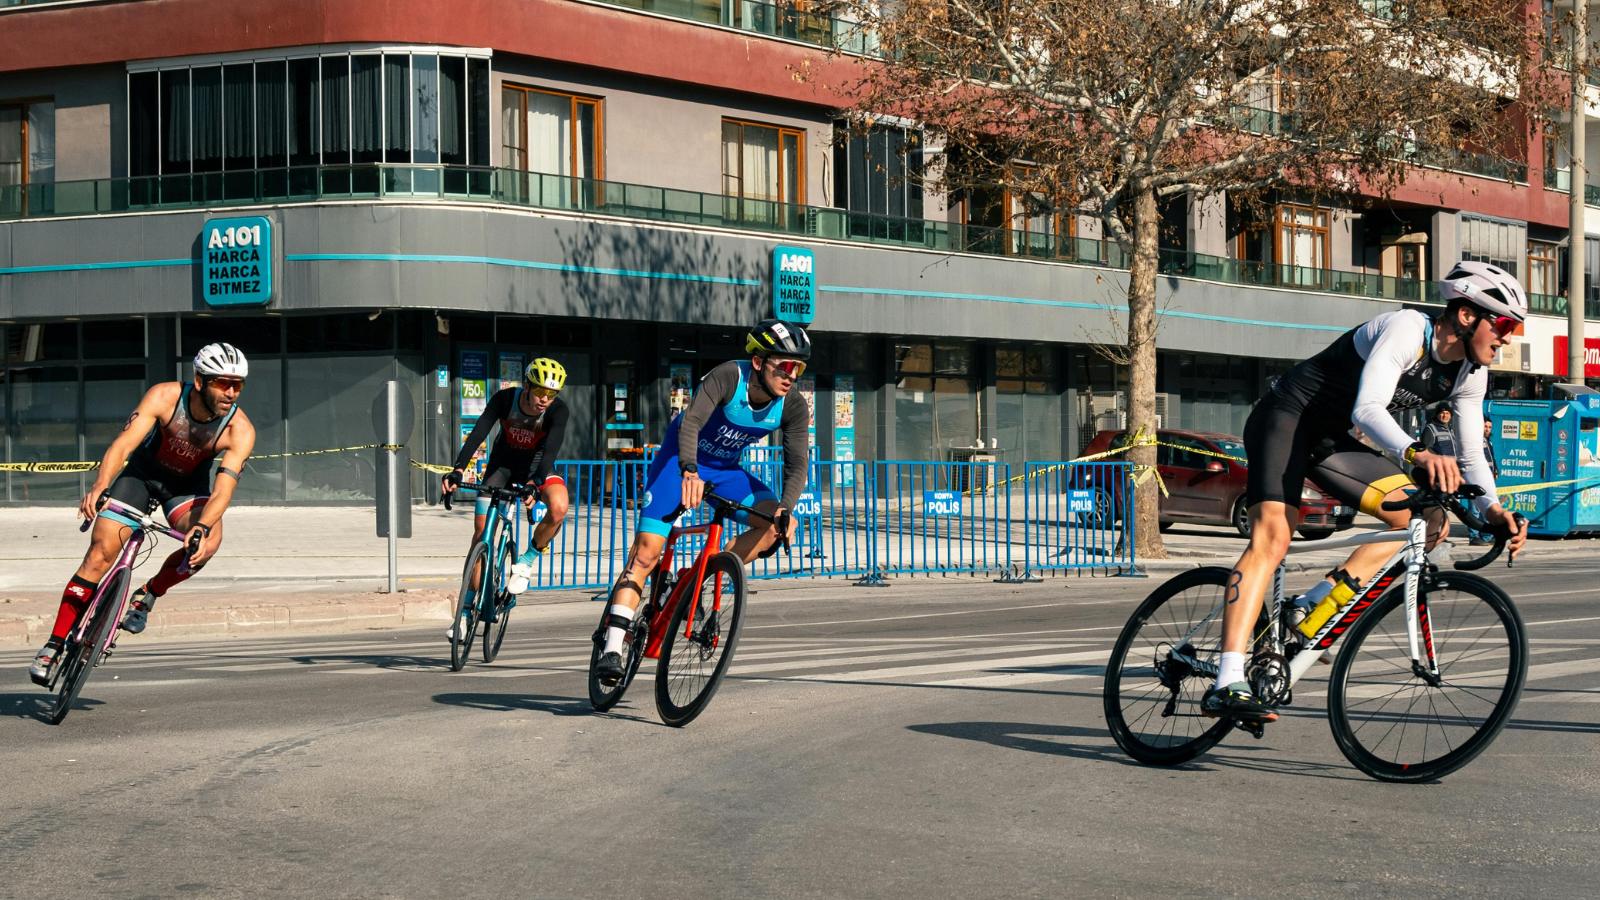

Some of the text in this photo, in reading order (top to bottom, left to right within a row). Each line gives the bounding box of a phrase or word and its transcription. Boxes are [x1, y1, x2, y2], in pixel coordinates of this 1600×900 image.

[209, 249, 260, 263] HARCA
[209, 265, 260, 279] HARCA
[780, 274, 811, 287] HARCA
[780, 288, 811, 301] HARCA
[463, 383, 481, 397] 750
[714, 434, 744, 448] TUR
[1509, 449, 1528, 457] ATIK
[1501, 458, 1535, 467] GETİRME
[1501, 469, 1534, 478] MERKEZİ
[1071, 498, 1092, 511] POLİS
[1514, 493, 1537, 503] SIFIR
[928, 500, 960, 514] POLİS
[1515, 502, 1536, 511] ATIK
[1228, 570, 1242, 604] 3
